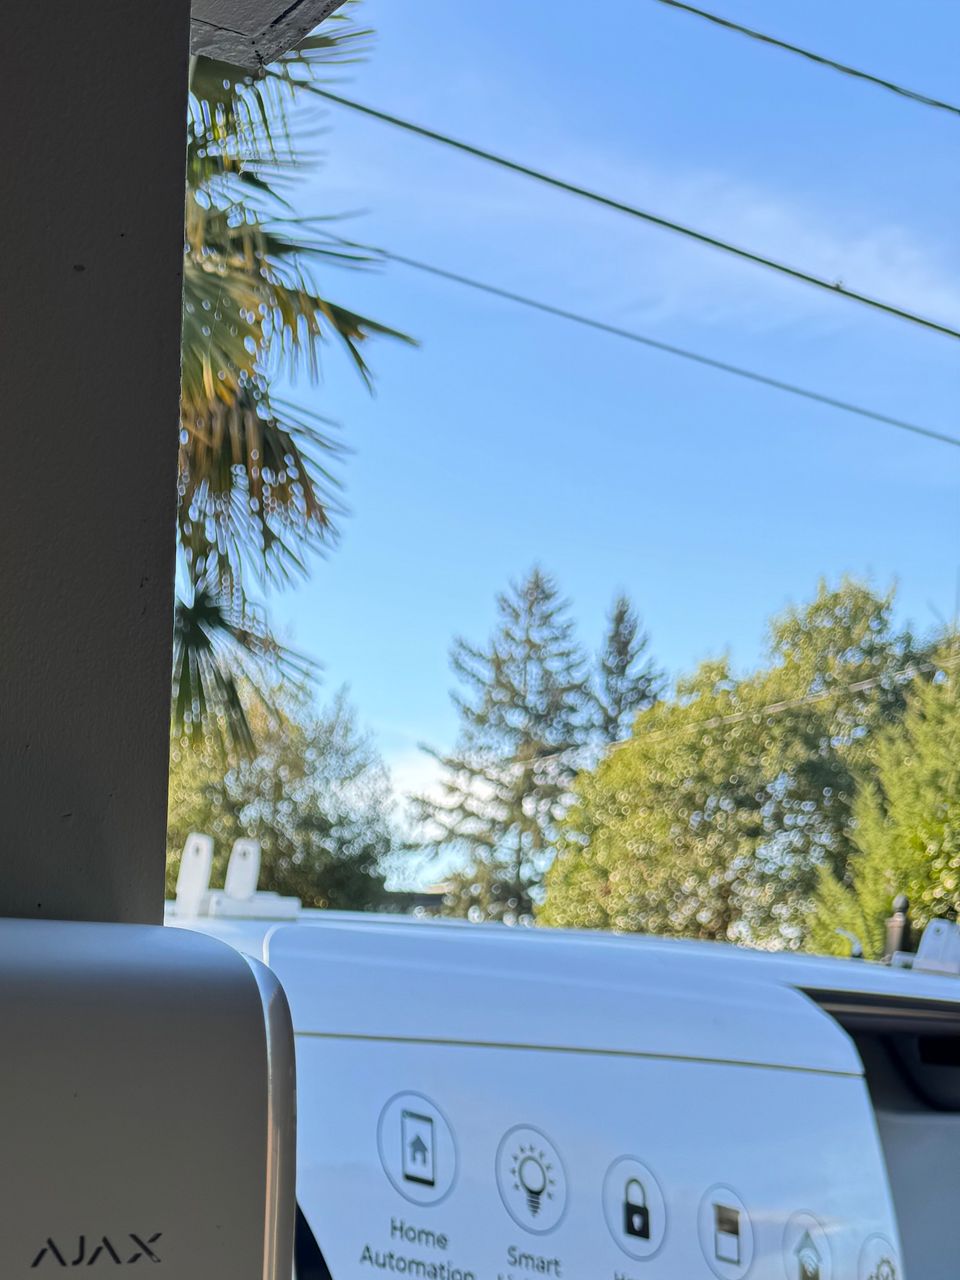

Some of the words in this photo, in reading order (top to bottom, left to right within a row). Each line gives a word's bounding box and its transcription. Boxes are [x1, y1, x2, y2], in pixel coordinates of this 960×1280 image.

[30, 1232, 162, 1268] AJAX
[390, 1217, 448, 1250] Home
[507, 1246, 561, 1278] Smart
